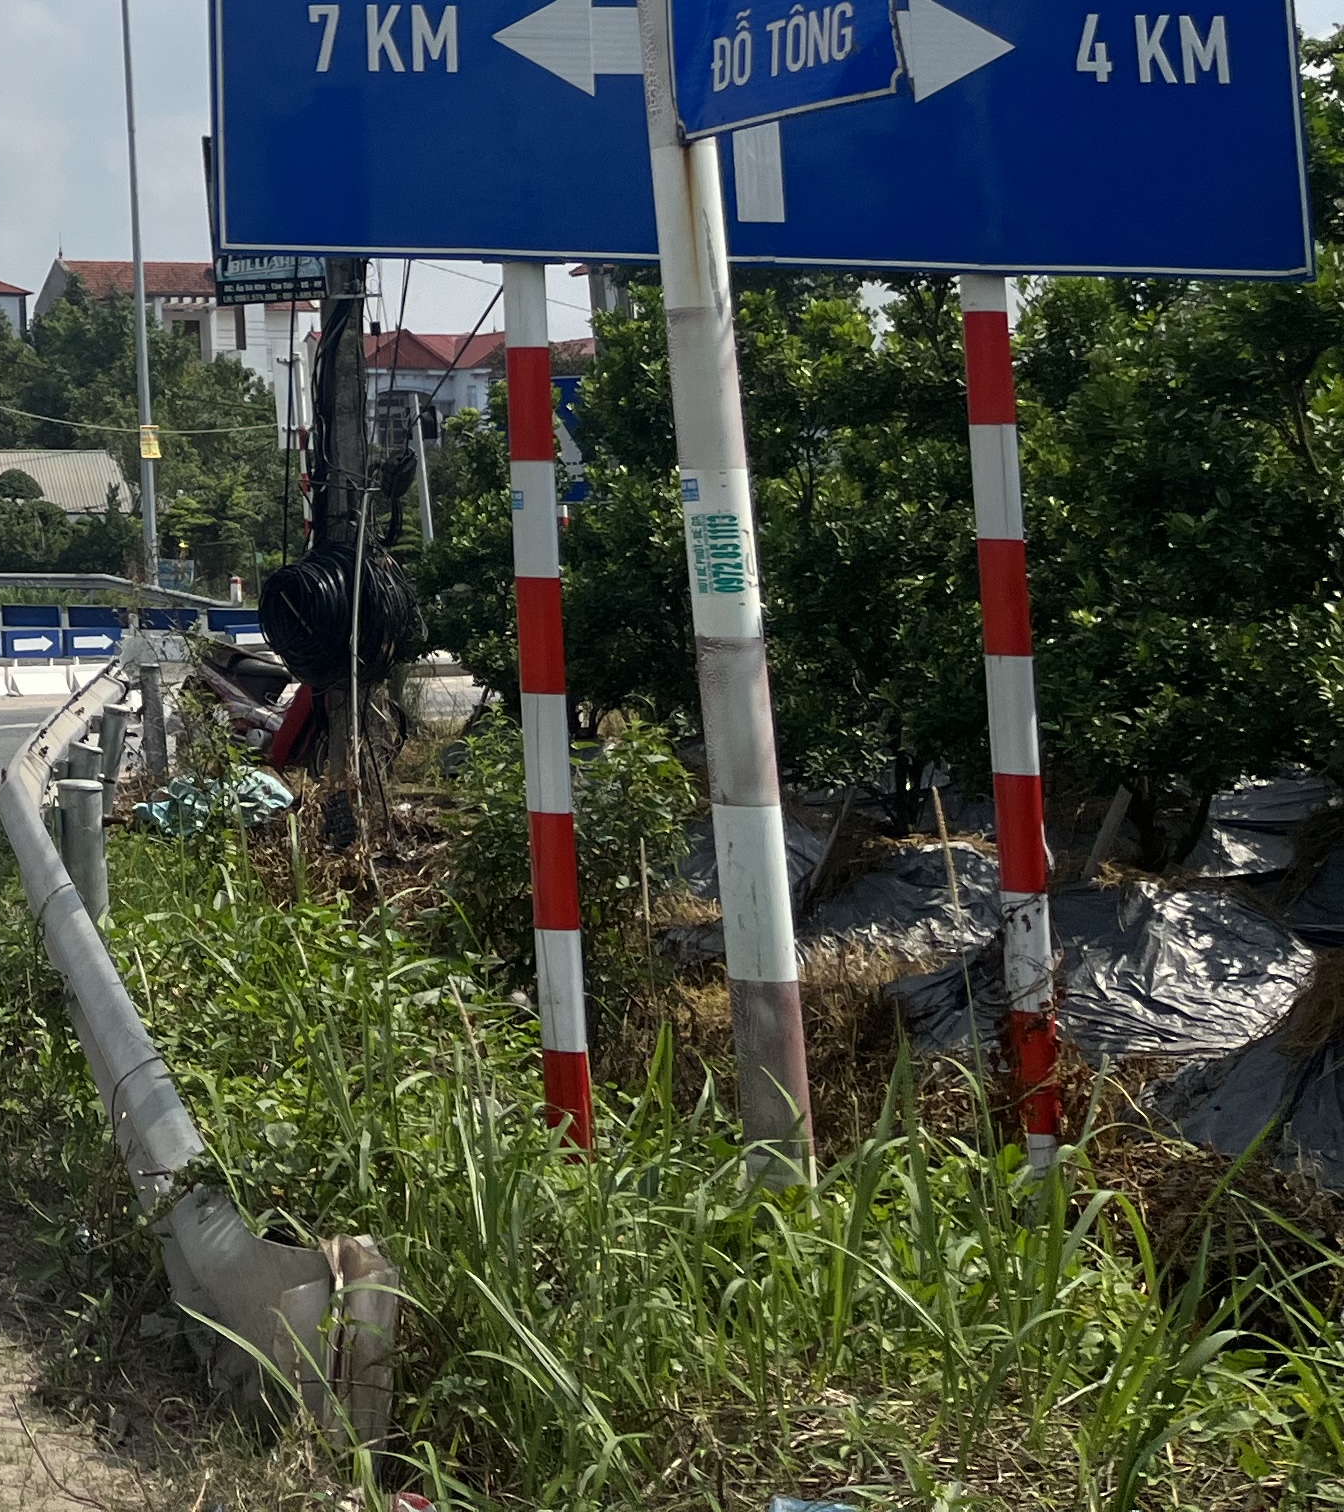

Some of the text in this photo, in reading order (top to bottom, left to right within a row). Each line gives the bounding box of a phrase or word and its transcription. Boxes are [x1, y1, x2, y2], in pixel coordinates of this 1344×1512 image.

[308, 4, 459, 73] 7 KM
[711, 3, 854, 92] ĐỖ TÔNG
[1077, 14, 1231, 84] 4 KM
